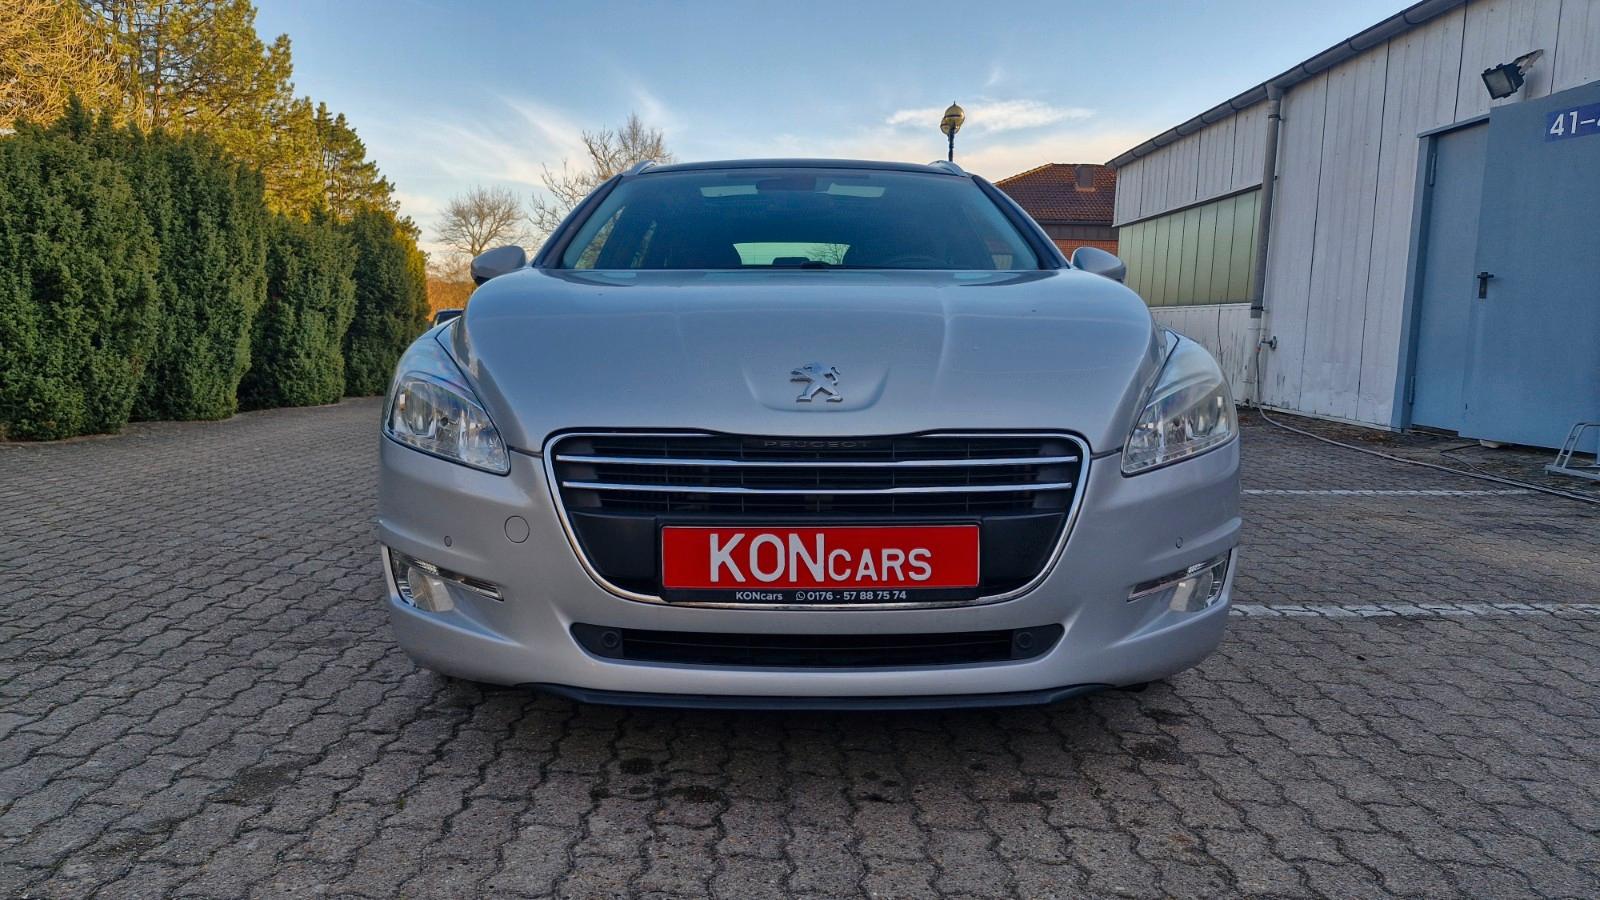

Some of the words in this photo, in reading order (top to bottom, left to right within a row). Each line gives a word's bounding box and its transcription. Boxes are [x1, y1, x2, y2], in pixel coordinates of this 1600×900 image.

[1549, 110, 1600, 136] 41-
[764, 440, 871, 448] PEUGEOT
[735, 591, 783, 601] KONcars
[807, 591, 834, 600] 0176
[843, 591, 857, 600] 57
[860, 591, 874, 600] 88
[876, 591, 890, 600] 75
[892, 590, 907, 600] 74
